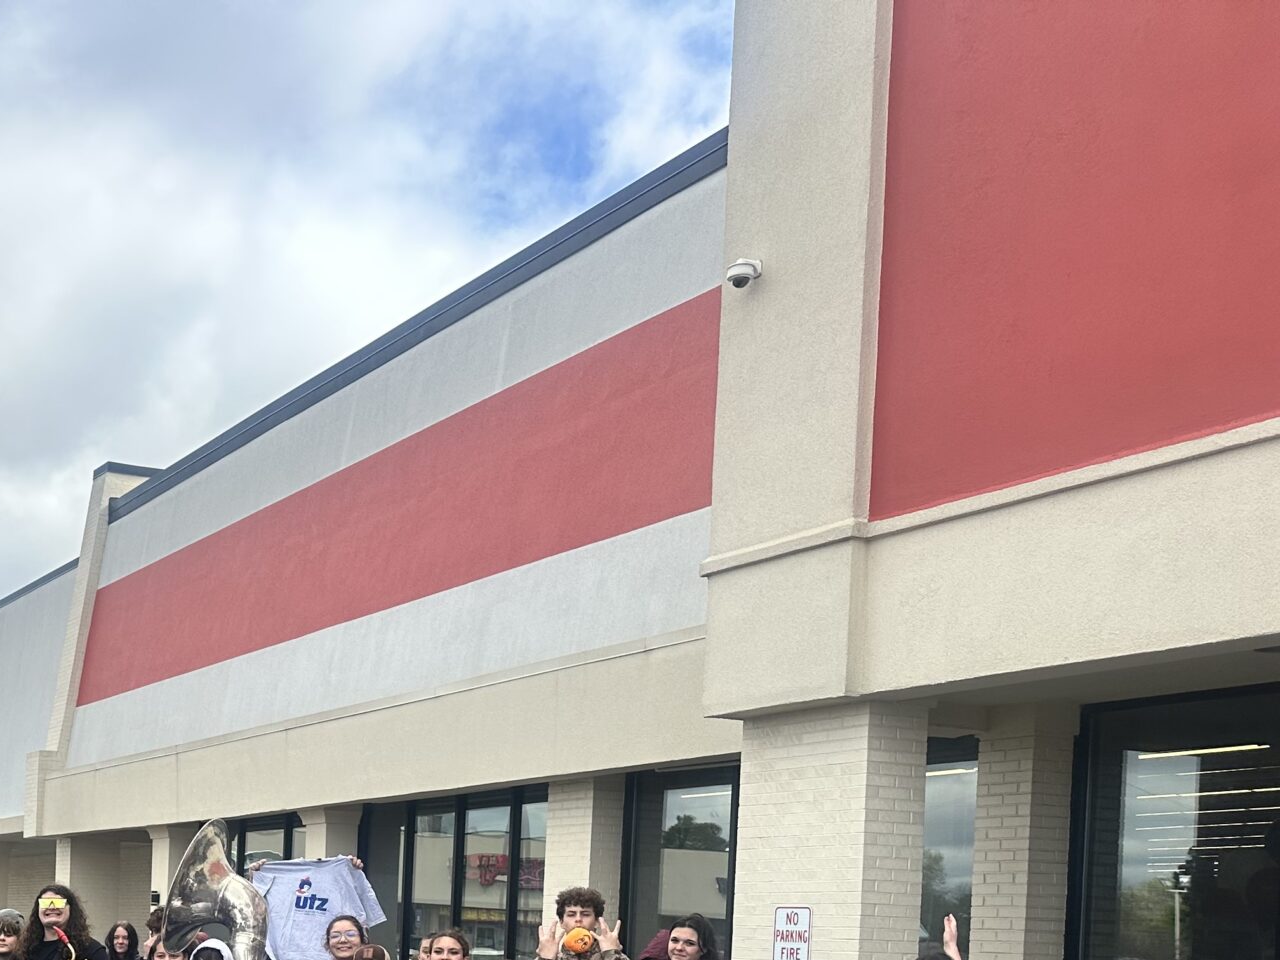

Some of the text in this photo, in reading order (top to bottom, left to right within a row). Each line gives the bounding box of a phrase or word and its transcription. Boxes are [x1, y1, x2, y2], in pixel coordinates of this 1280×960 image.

[295, 894, 329, 911] utz
[786, 911, 799, 926] NO
[776, 929, 808, 944] PARKING
[781, 947, 801, 960] FIRE
